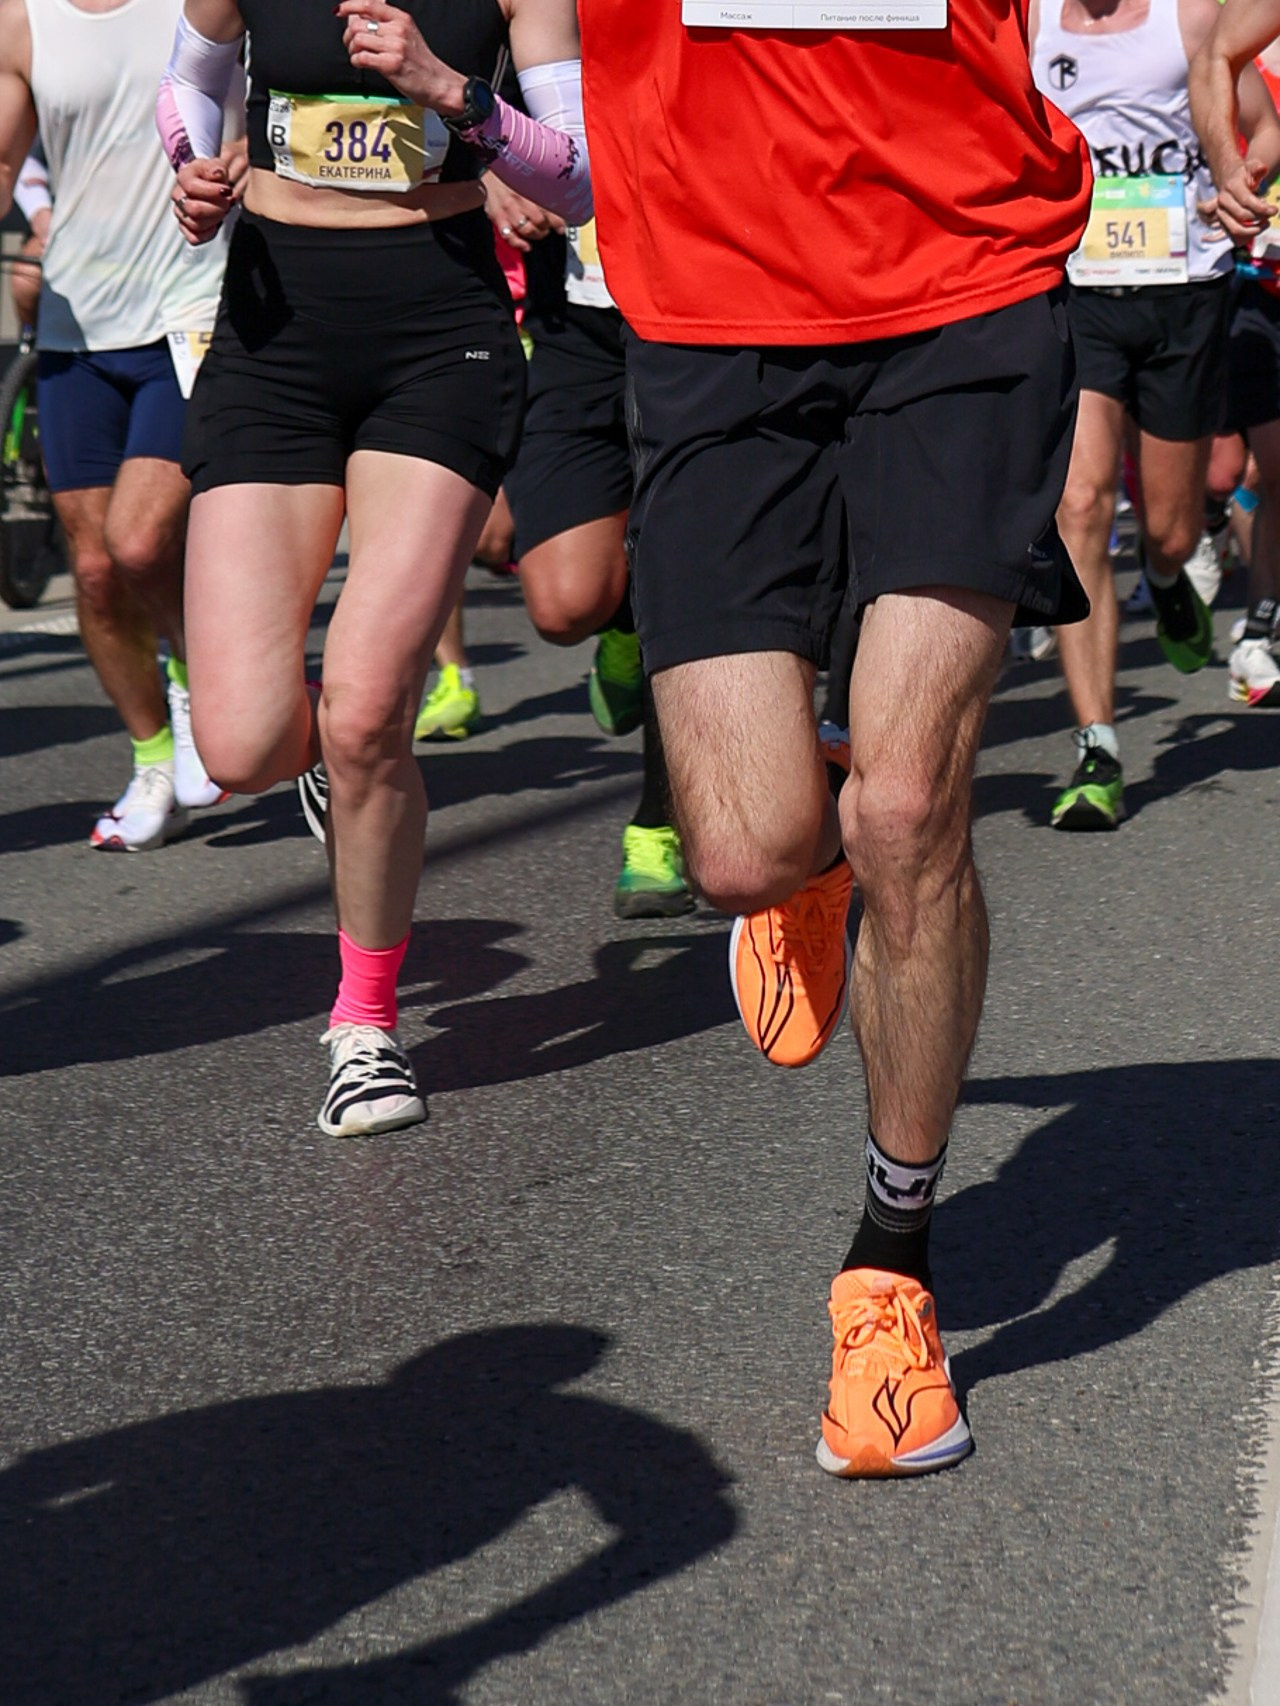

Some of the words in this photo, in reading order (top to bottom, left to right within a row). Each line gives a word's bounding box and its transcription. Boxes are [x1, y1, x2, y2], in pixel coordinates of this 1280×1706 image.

[720, 11, 752, 20] Массаж
[820, 13, 857, 22] Питание
[859, 14, 884, 22] после
[886, 13, 920, 23] финиша
[324, 120, 392, 163] 384
[318, 165, 392, 180] ЕКАТЕРИНА
[1106, 221, 1146, 249] 541
